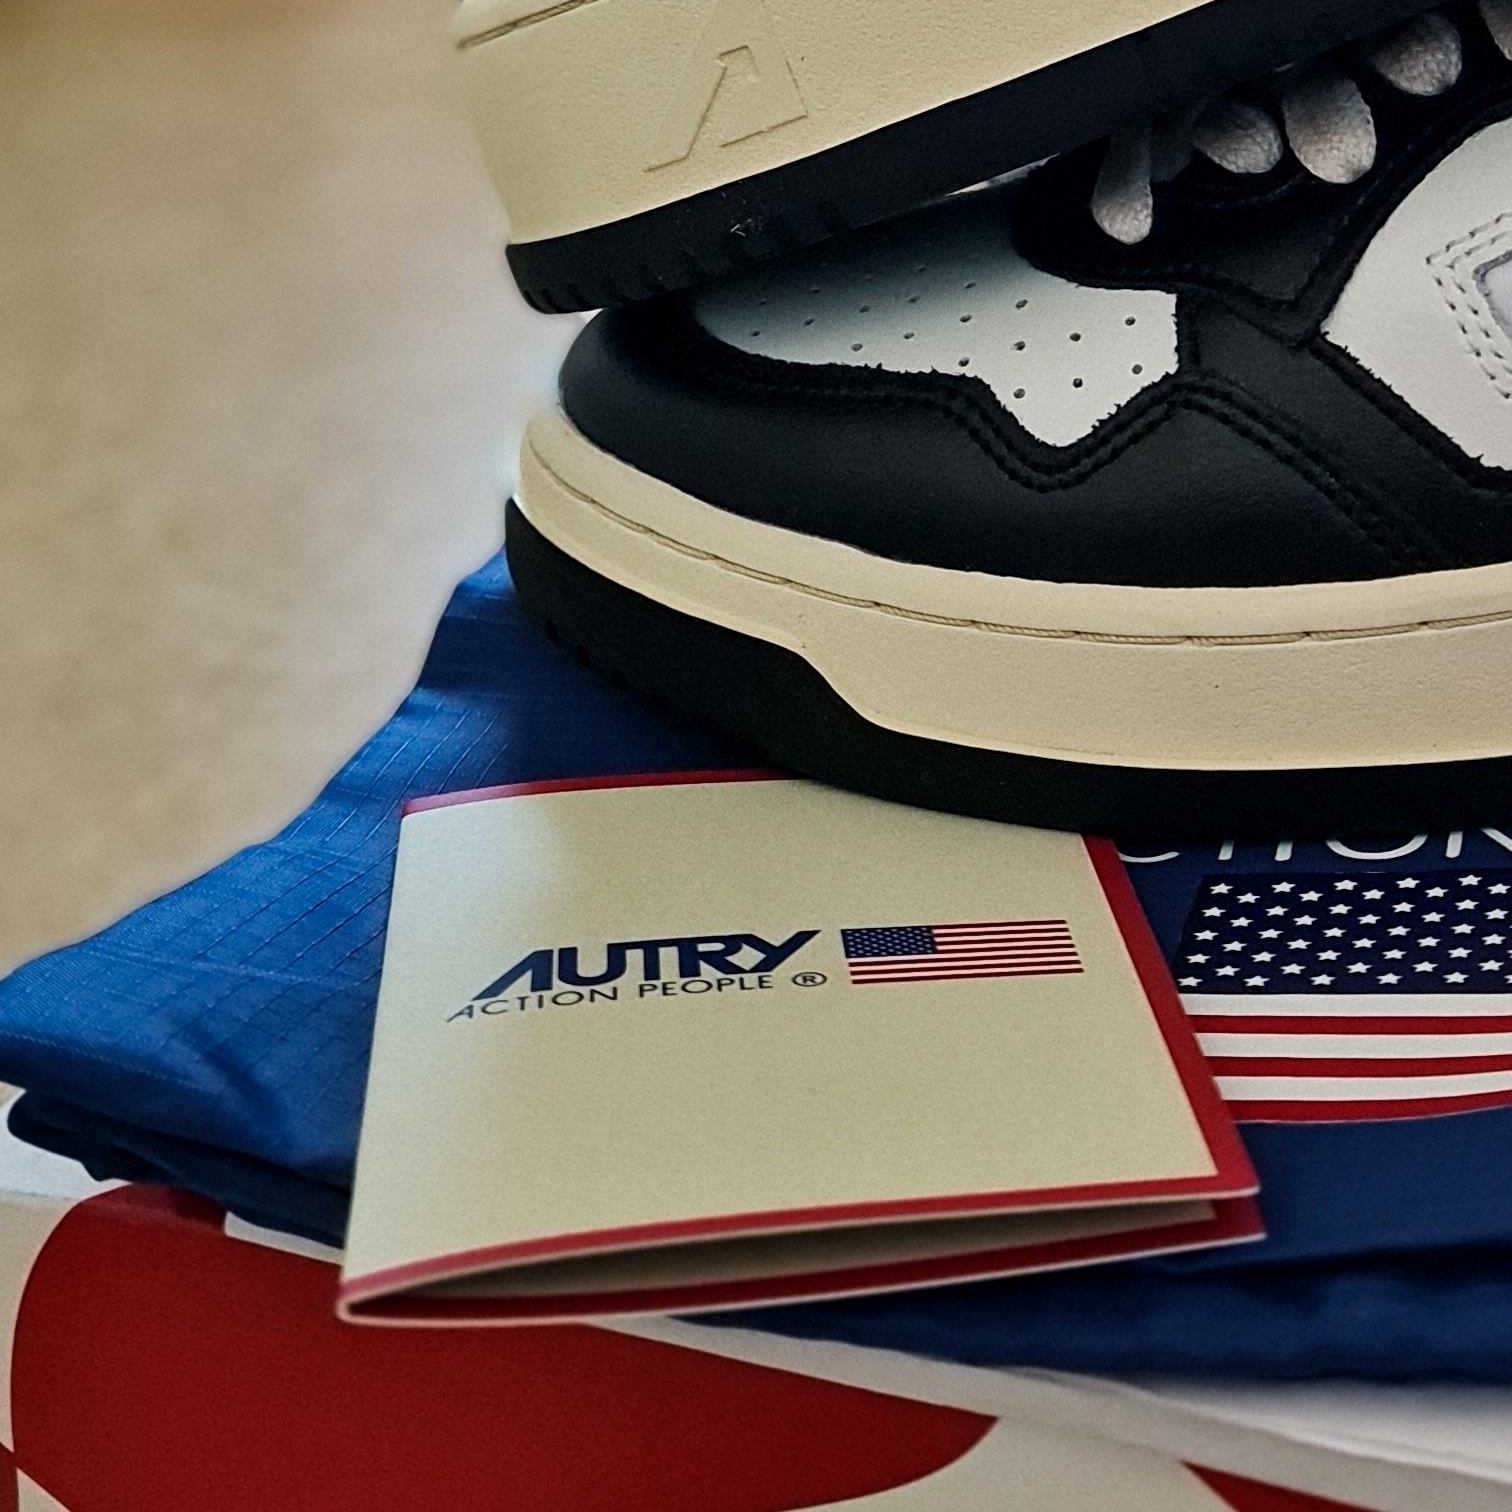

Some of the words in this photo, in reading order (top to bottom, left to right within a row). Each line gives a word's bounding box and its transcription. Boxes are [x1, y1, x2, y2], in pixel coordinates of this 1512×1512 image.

[471, 929, 822, 1002] AUTRY
[446, 985, 619, 1023] ACTION
[638, 973, 774, 999] PEOPLE
